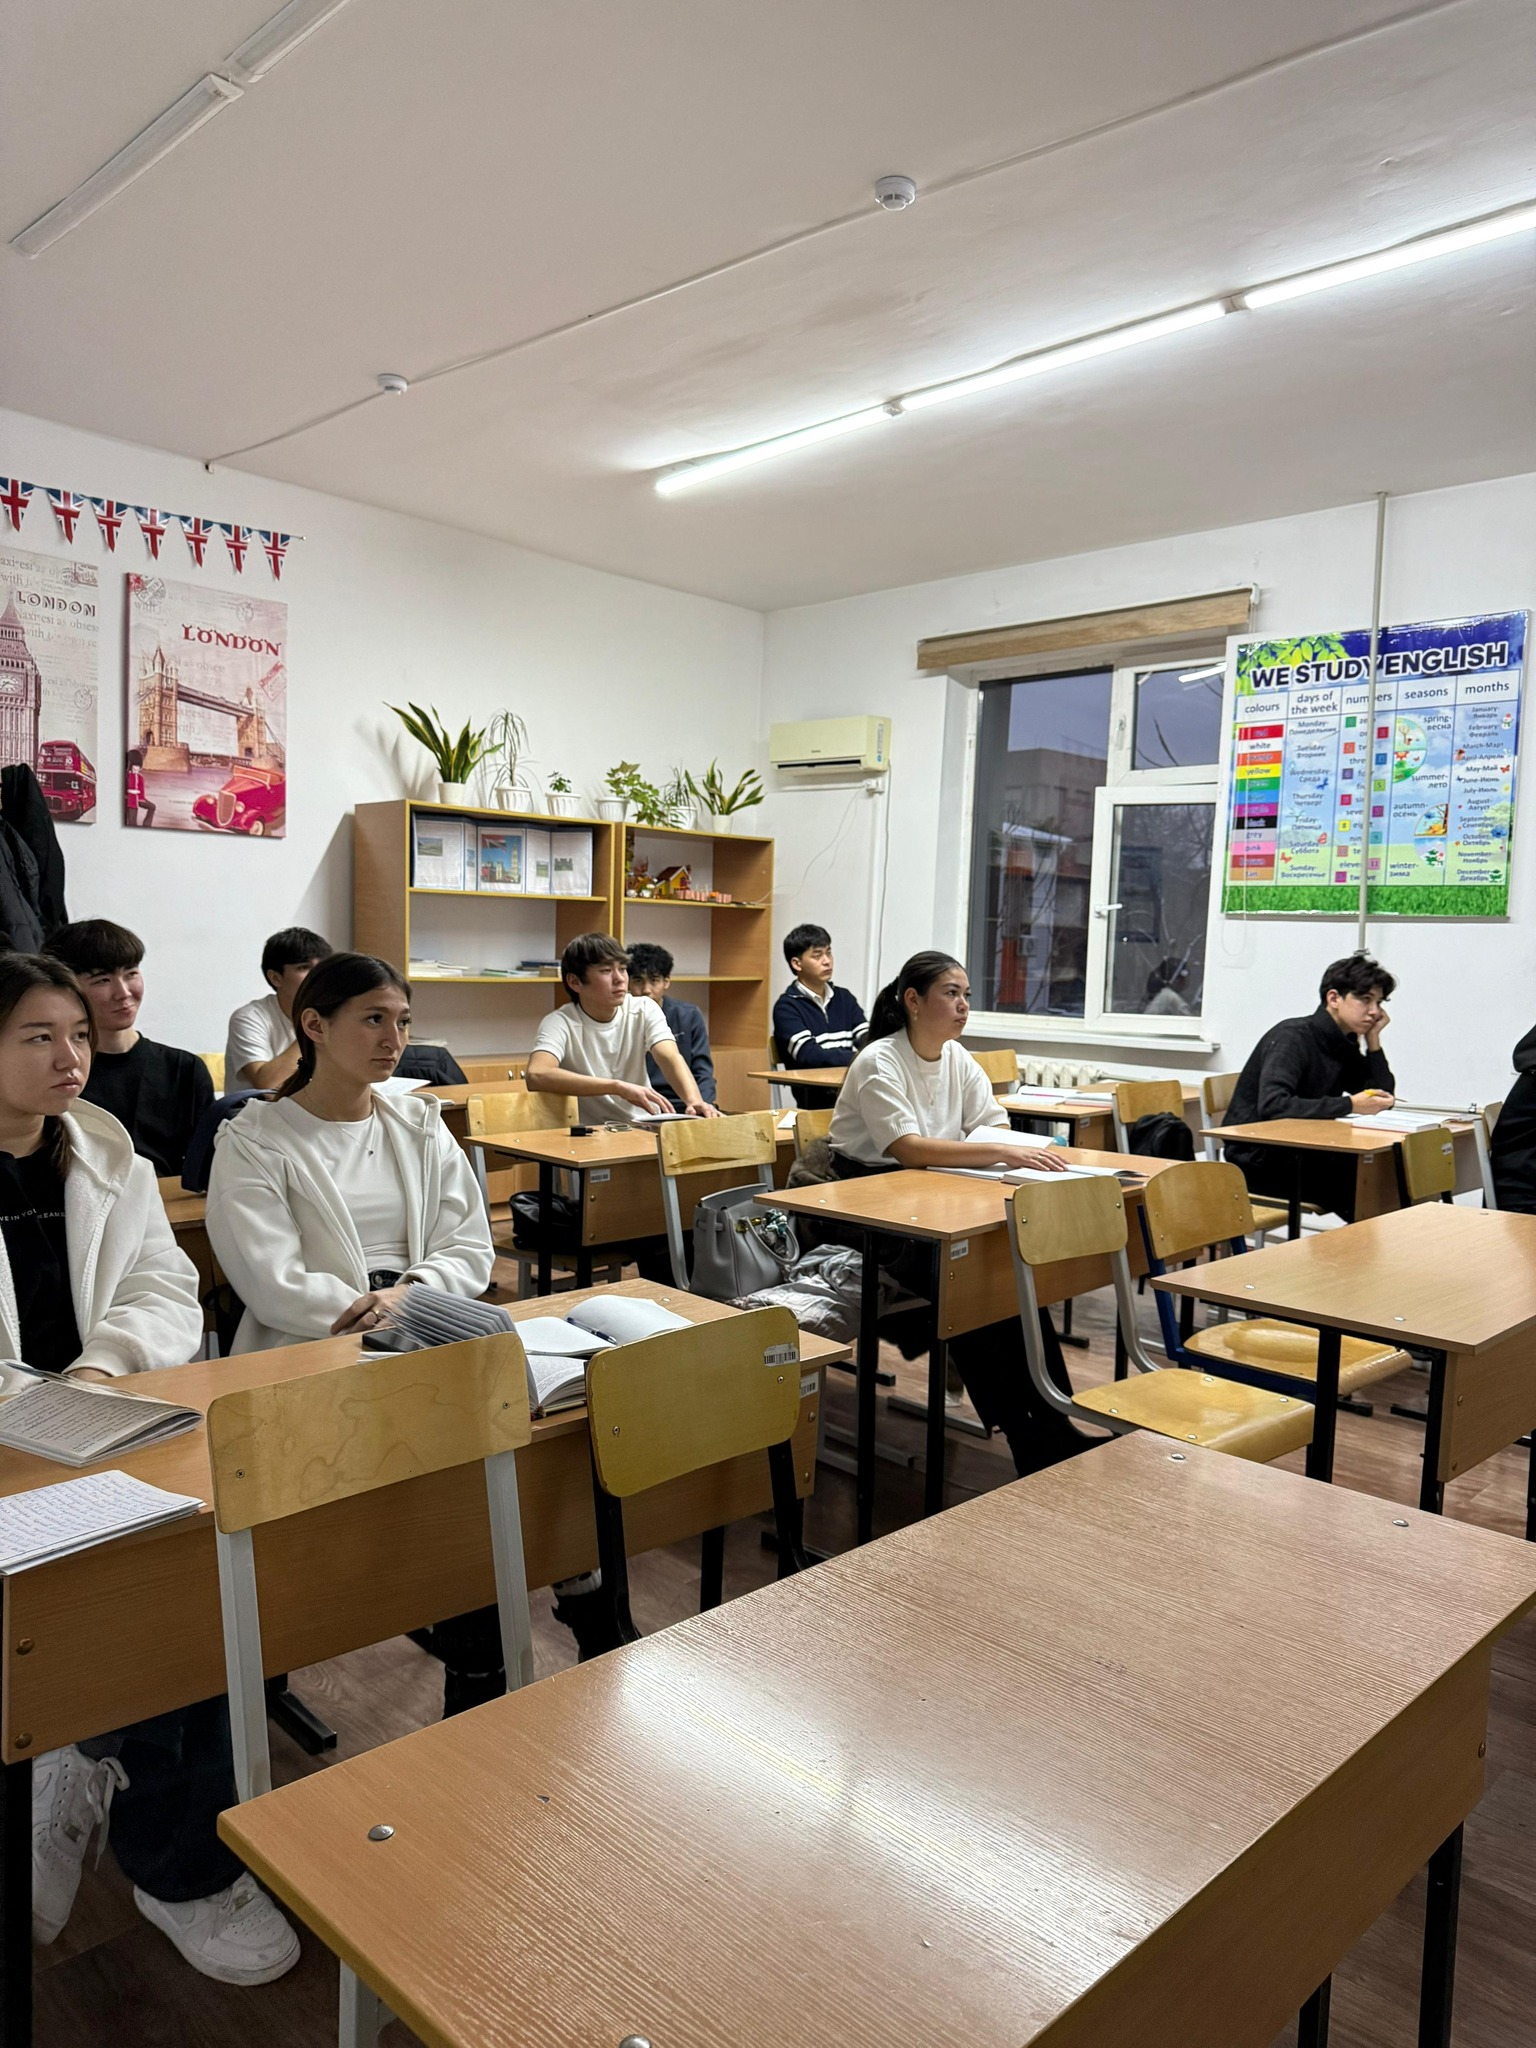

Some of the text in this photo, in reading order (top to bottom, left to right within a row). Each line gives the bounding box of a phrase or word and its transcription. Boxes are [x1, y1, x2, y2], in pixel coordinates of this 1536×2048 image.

[17, 591, 96, 617] LONDON
[182, 624, 282, 657] LONDON
[1252, 643, 1507, 689] WE STUDY ENGLISH
[1405, 688, 1448, 699] seasons
[1465, 682, 1510, 695] months
[1297, 691, 1334, 706] days of
[1346, 693, 1393, 704] numers
[1245, 703, 1280, 714] colours
[1291, 702, 1338, 715] the week
[1246, 768, 1271, 776] yellow
[1339, 860, 1360, 868] eleve
